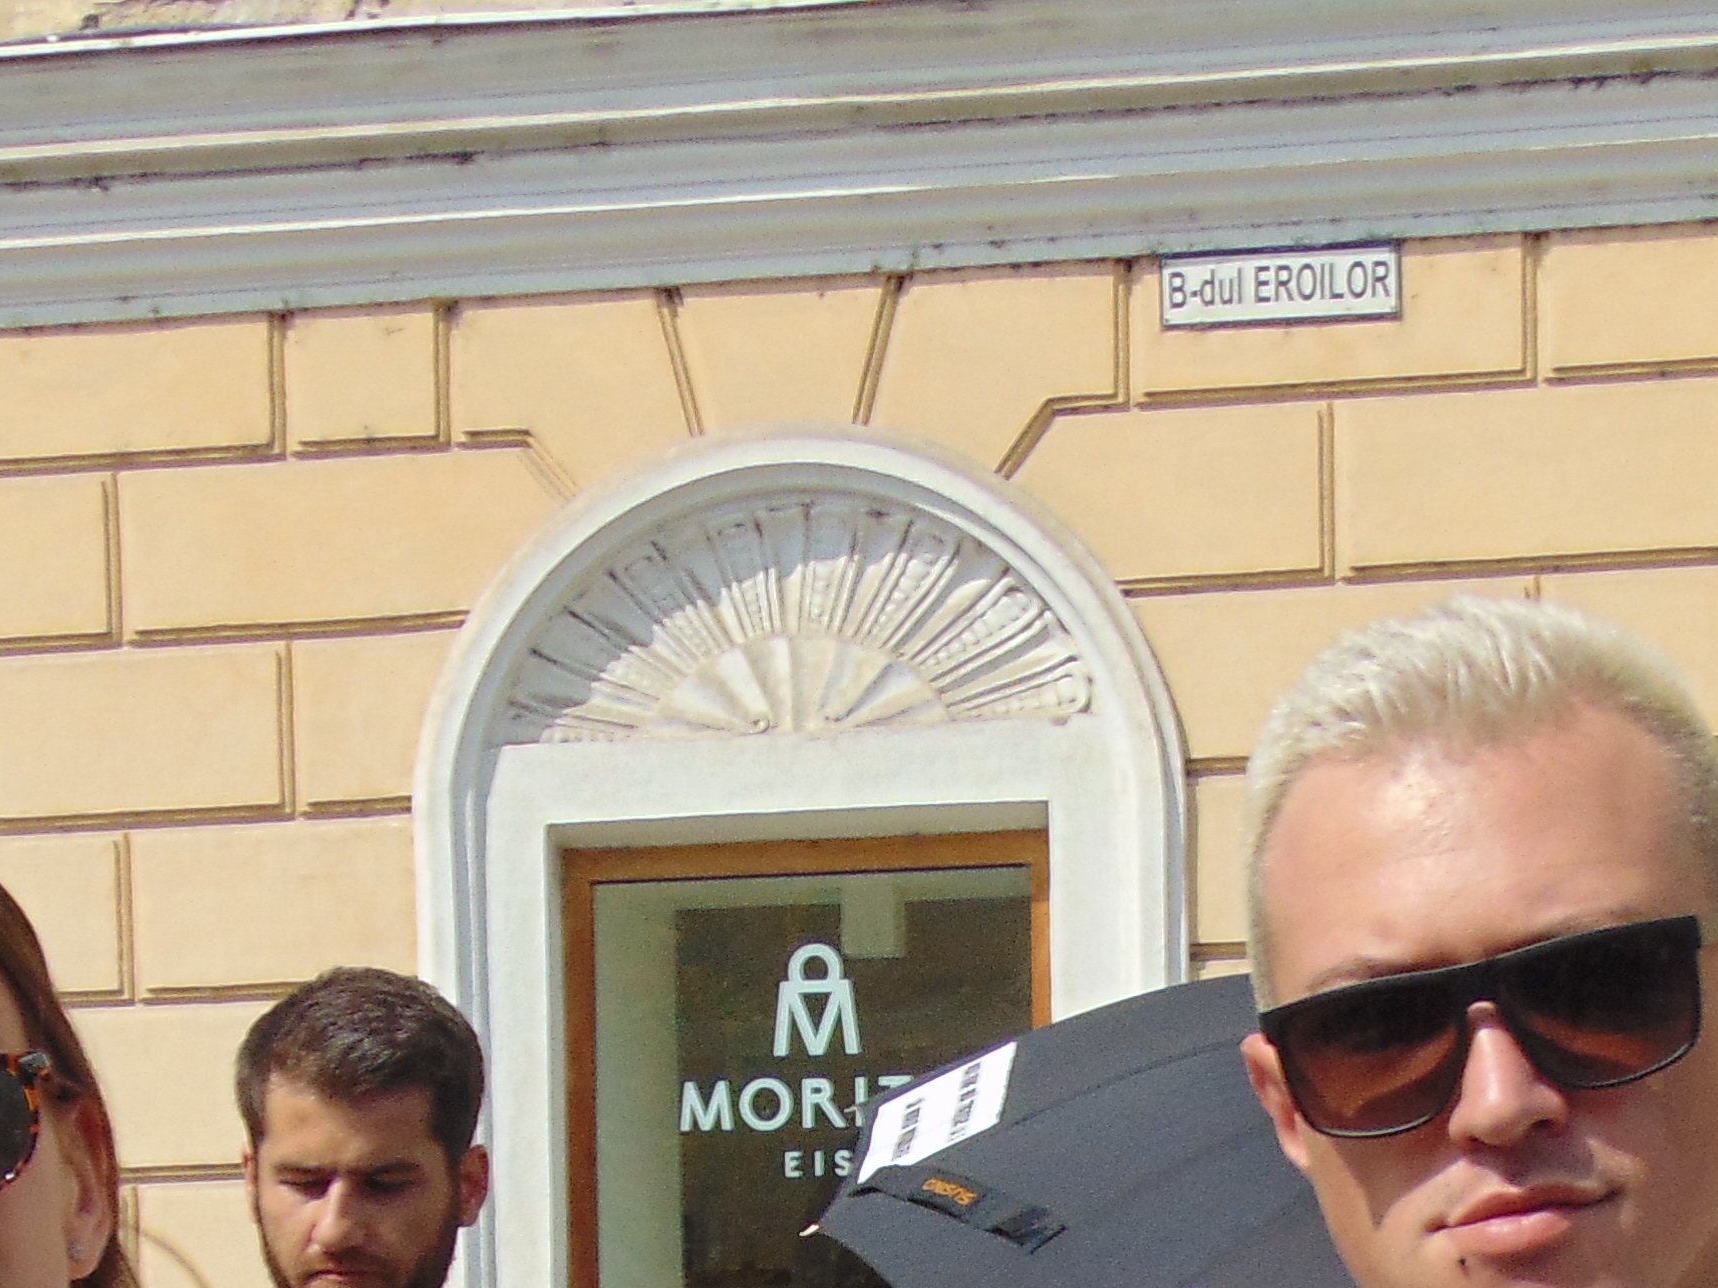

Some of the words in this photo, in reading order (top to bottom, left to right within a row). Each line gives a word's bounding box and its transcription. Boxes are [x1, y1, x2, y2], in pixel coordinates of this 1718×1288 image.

[1168, 267, 1242, 309] B-dul
[1254, 260, 1390, 303] EROILOR
[785, 1150, 853, 1177] EIS
